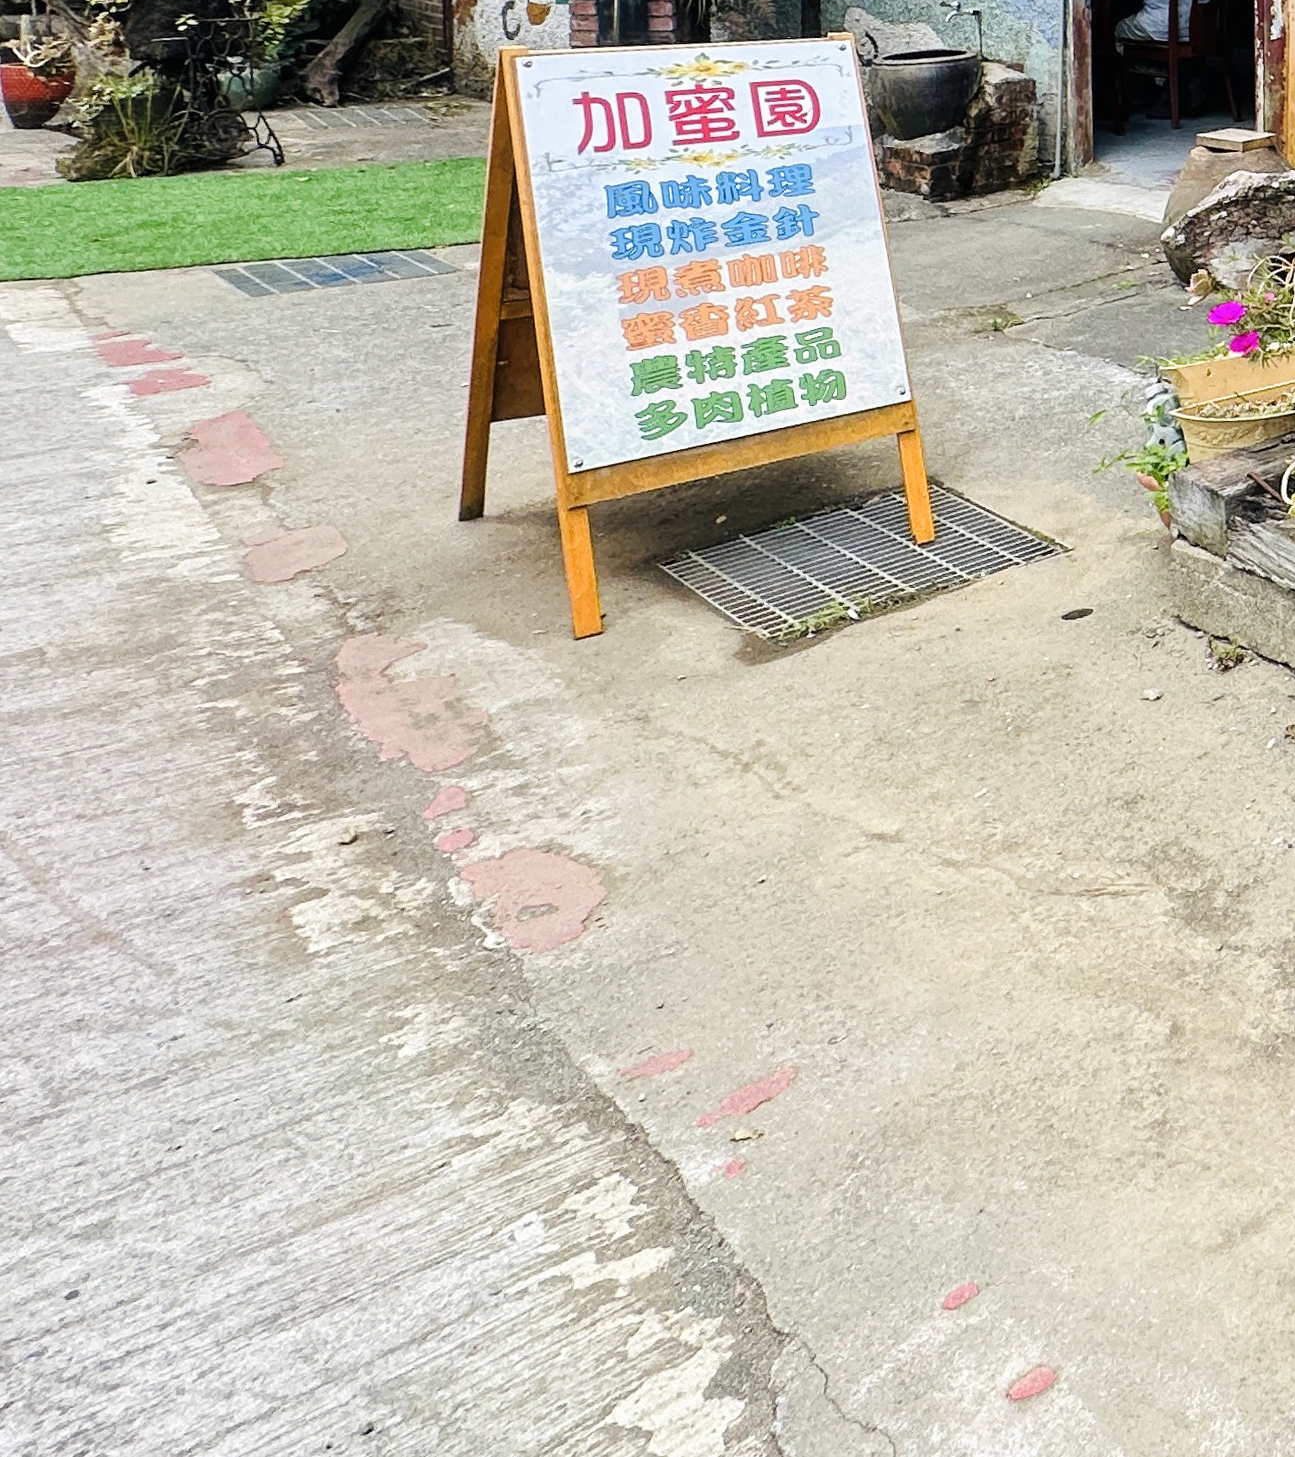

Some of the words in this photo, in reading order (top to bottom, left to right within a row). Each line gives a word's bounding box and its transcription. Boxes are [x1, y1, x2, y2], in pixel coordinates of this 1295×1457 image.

[572, 79, 821, 155] 加蜜園
[606, 163, 815, 219] 風味料理
[610, 204, 820, 261] 現炸金針
[616, 245, 829, 304] 現煮咖啡
[621, 285, 834, 351] 蜜香紅茶
[630, 327, 842, 397] 農特產品
[634, 369, 847, 441] 多肉植物
